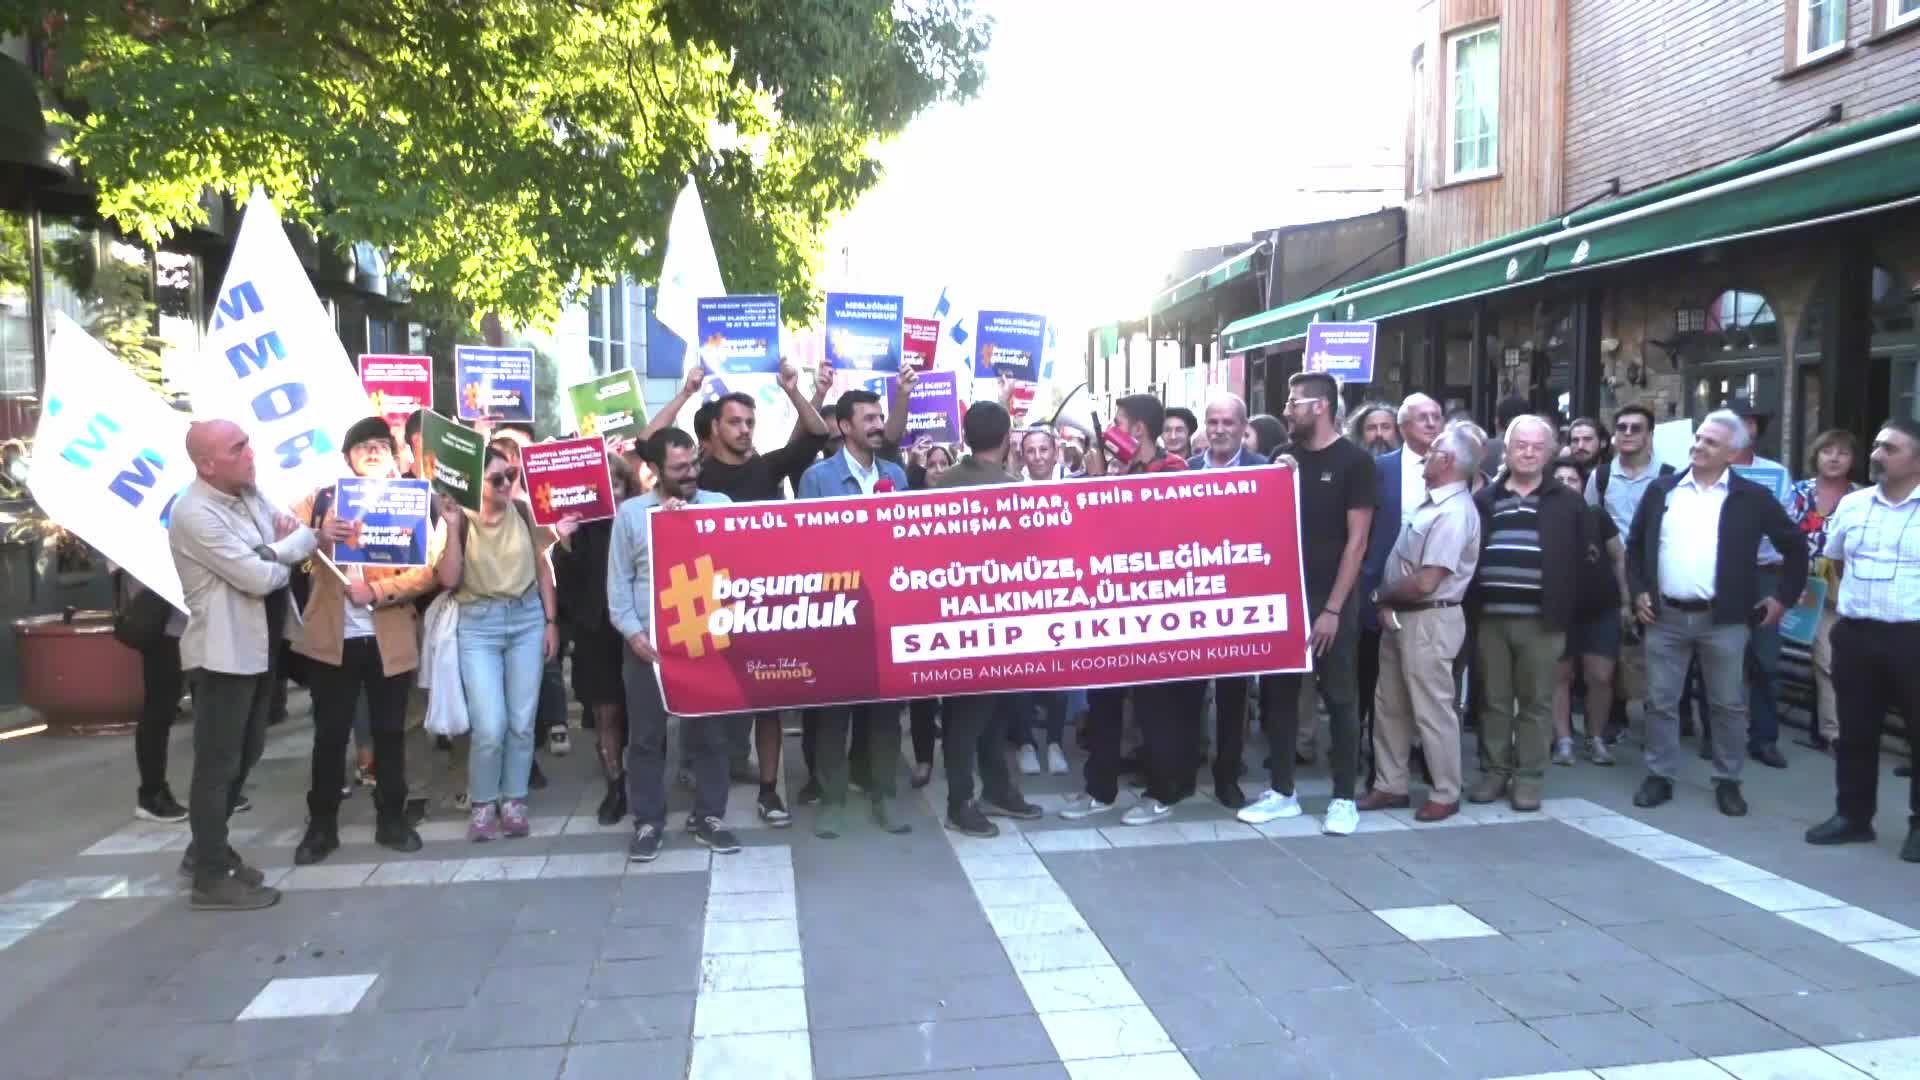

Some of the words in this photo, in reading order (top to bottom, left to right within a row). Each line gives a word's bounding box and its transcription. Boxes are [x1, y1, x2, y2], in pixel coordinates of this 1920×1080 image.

[695, 520, 716, 534] 19
[724, 513, 788, 532] EYLÜL
[794, 508, 869, 527] TMMOB
[876, 499, 989, 522] MÜHENDİS,
[996, 490, 1069, 513] MİMAR,
[1076, 487, 1134, 510] ŞEHİR
[1141, 480, 1258, 502] PLANCILARI
[892, 515, 1012, 539] DAYANIŞMA
[1019, 507, 1073, 529] GÜNÜ
[888, 555, 1084, 592] ÖRGÜTÜMÜZE,
[1089, 539, 1272, 575] MESLEĞİMİZE,
[707, 593, 859, 636] okuduk
[904, 625, 1023, 653] SAHİP
[1047, 603, 1276, 647] ÇIKIYORUZ!
[911, 666, 974, 686] TMMOB
[979, 661, 1047, 679] ANKARA
[1051, 658, 1066, 673] İL
[1071, 647, 1201, 671] KOORDİNASYON
[1206, 641, 1272, 660] KURULU
